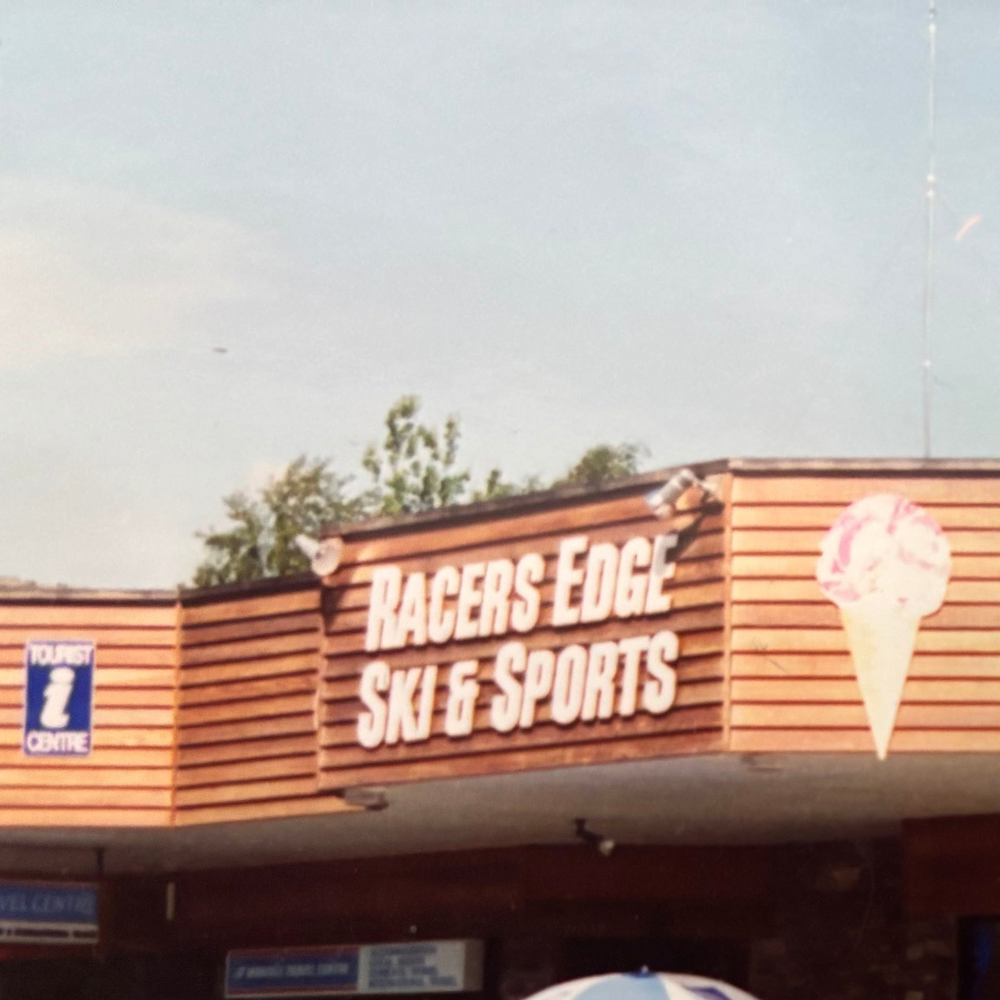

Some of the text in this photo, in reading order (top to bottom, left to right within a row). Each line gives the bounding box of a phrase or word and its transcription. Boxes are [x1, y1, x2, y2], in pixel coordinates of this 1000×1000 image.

[364, 533, 679, 652] RACERS EDGE
[29, 644, 95, 666] TOURIST
[356, 630, 680, 749] SKI & SPORTS
[26, 731, 90, 754] CENTRE
